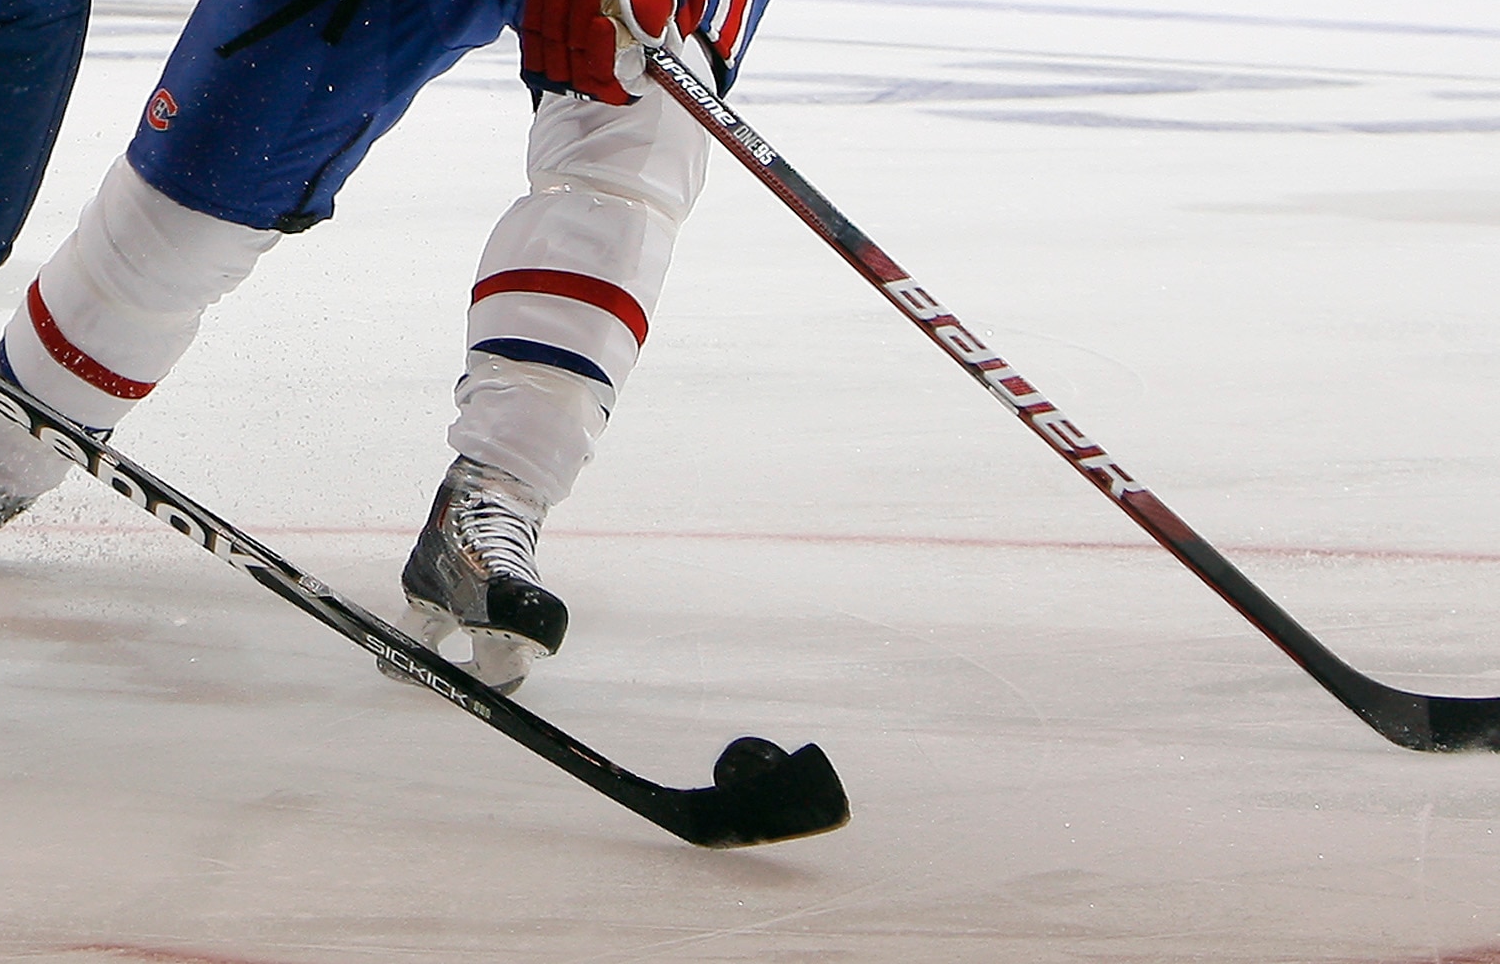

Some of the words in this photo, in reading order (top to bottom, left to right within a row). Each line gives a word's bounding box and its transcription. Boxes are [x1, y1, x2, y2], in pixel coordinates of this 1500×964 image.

[652, 49, 737, 128] UPREME
[881, 277, 1148, 500] BAUER
[363, 634, 469, 708] SICKICK
